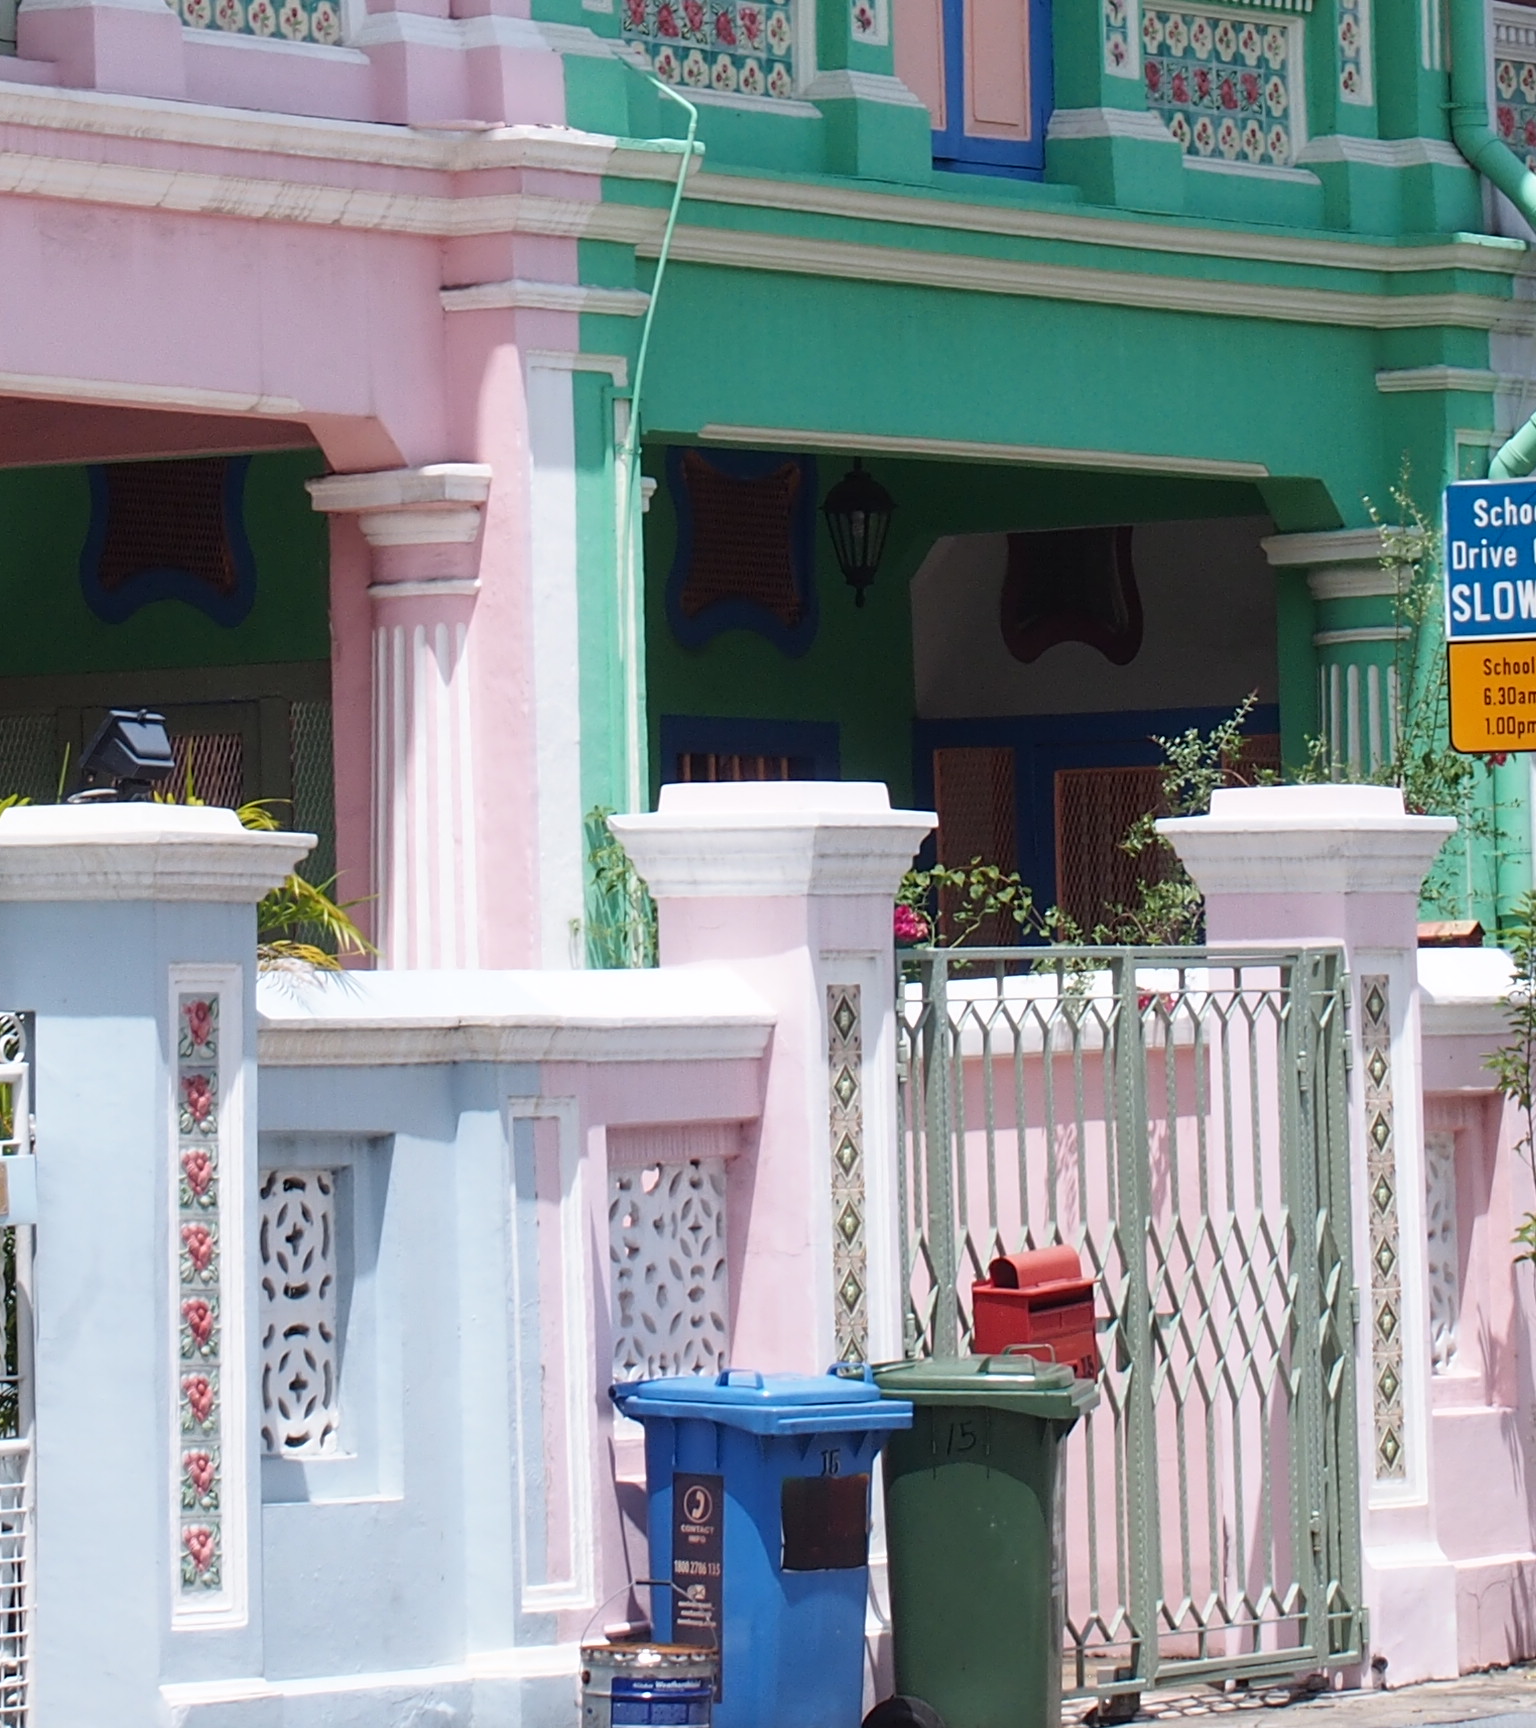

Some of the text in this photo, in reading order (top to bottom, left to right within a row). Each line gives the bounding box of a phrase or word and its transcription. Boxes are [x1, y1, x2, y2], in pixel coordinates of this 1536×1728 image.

[1452, 539, 1518, 570] Drive
[1483, 656, 1536, 676] School
[946, 1421, 977, 1456] 15
[680, 1524, 715, 1535] CONTACT
[674, 1560, 690, 1575] 1800
